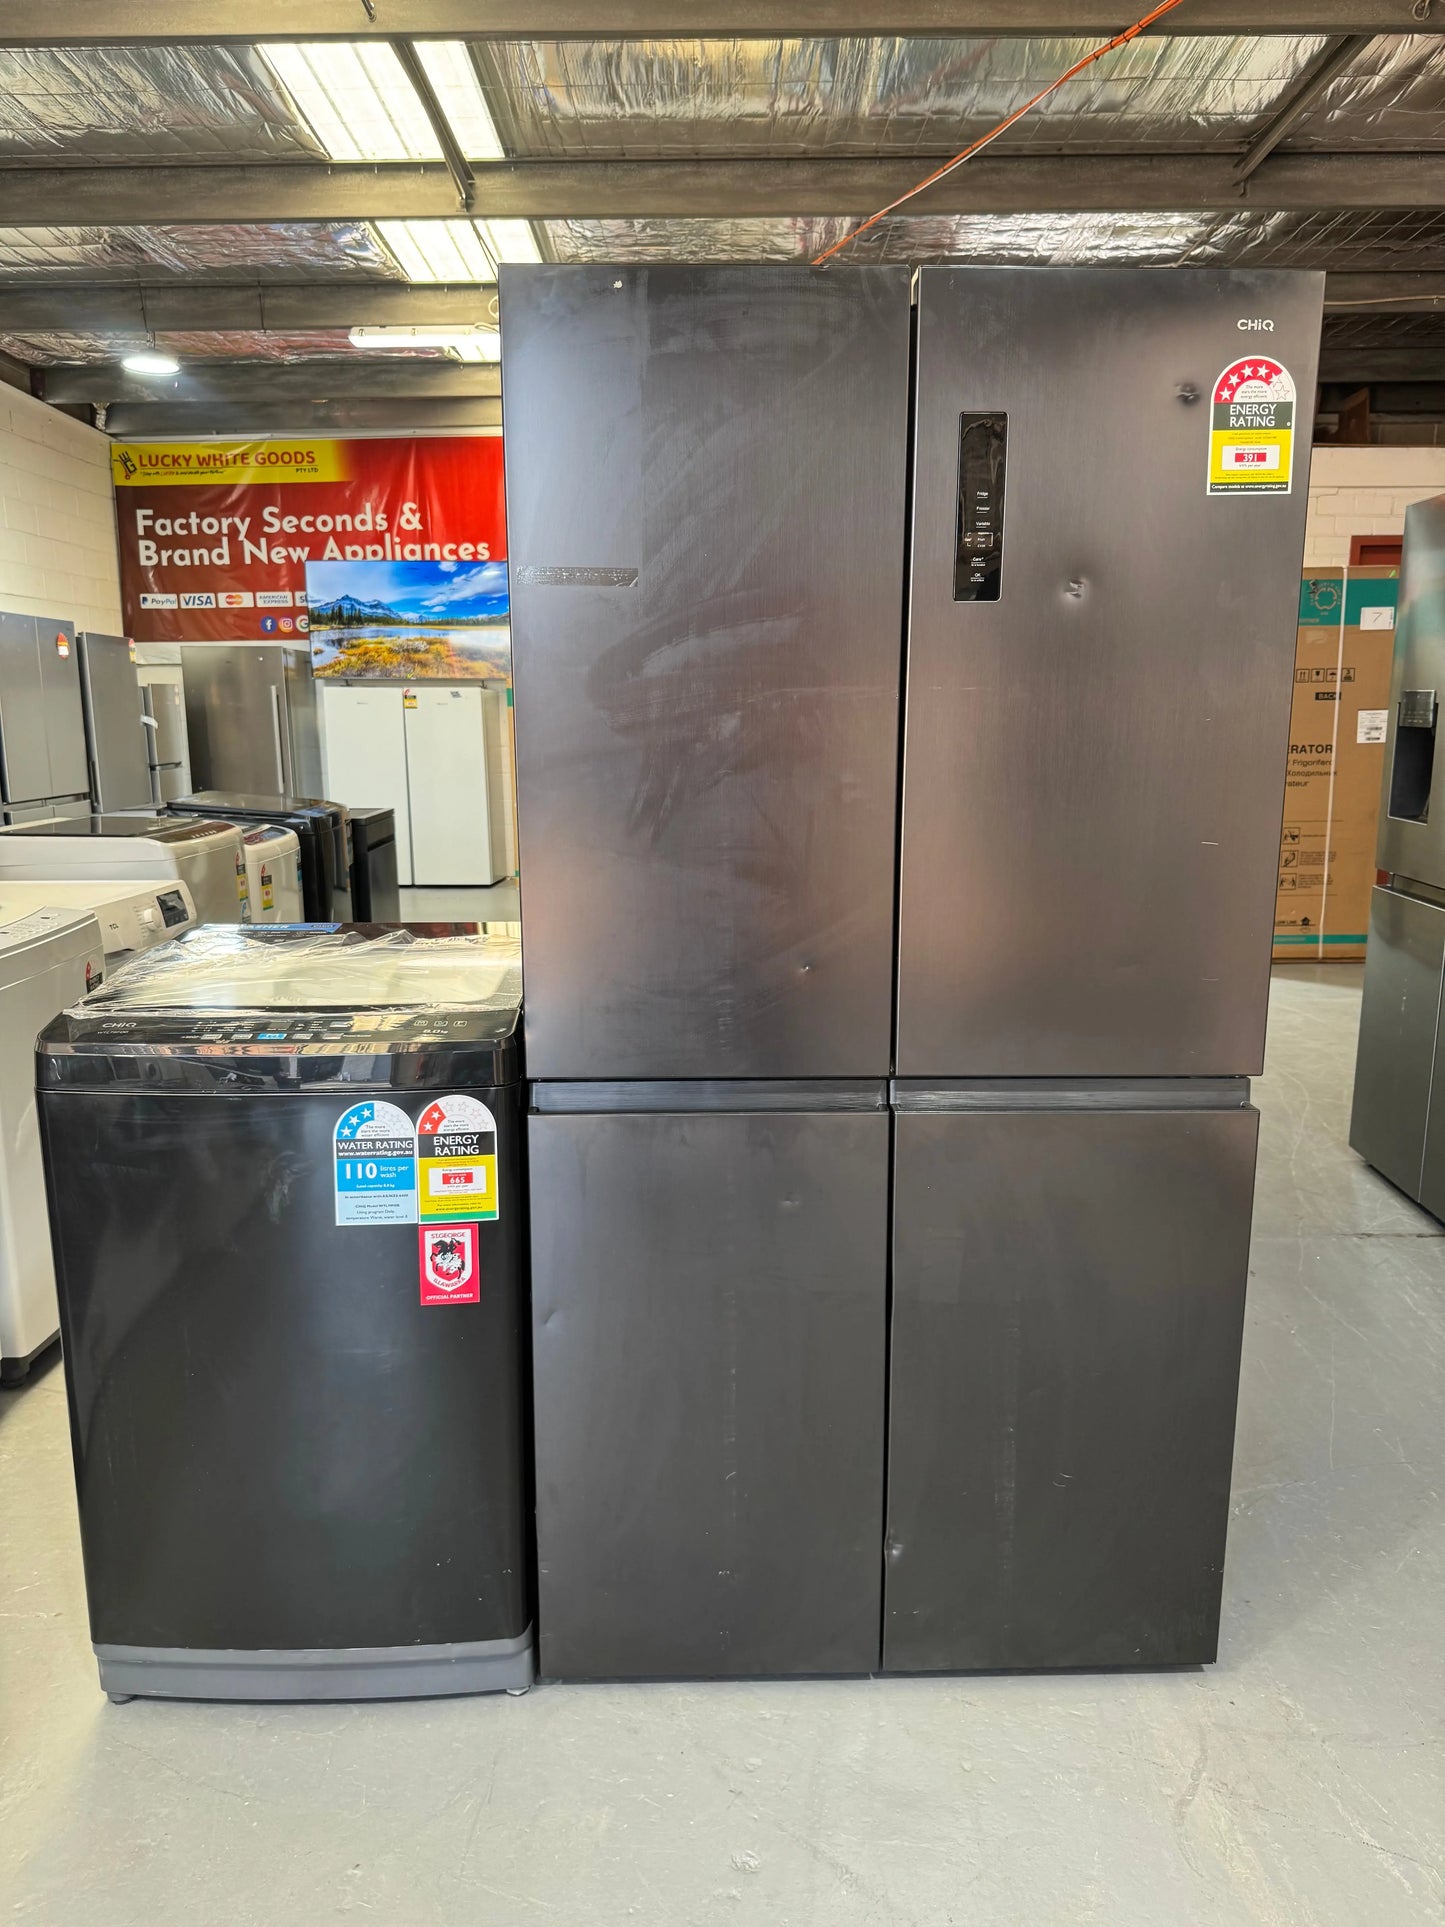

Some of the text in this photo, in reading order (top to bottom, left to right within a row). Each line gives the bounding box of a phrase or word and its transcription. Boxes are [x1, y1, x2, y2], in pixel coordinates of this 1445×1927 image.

[1236, 319, 1274, 331] CHiQ
[1229, 404, 1277, 415] ENERGY
[1229, 416, 1275, 427] RATING
[139, 450, 315, 467] LUCKY WHITE GOODS
[1243, 454, 1258, 462] 391
[135, 502, 423, 541] Factory Seconds &
[138, 533, 491, 567] Brand New Appliances
[151, 598, 177, 606] PayPal
[182, 595, 213, 606] VISA
[1288, 744, 1333, 754] RATOR
[338, 1140, 413, 1150] WATER RATING
[433, 1134, 479, 1146] ENERGY
[435, 1145, 480, 1156] RATING
[345, 1162, 378, 1179] 110
[450, 1176, 465, 1184] 665
